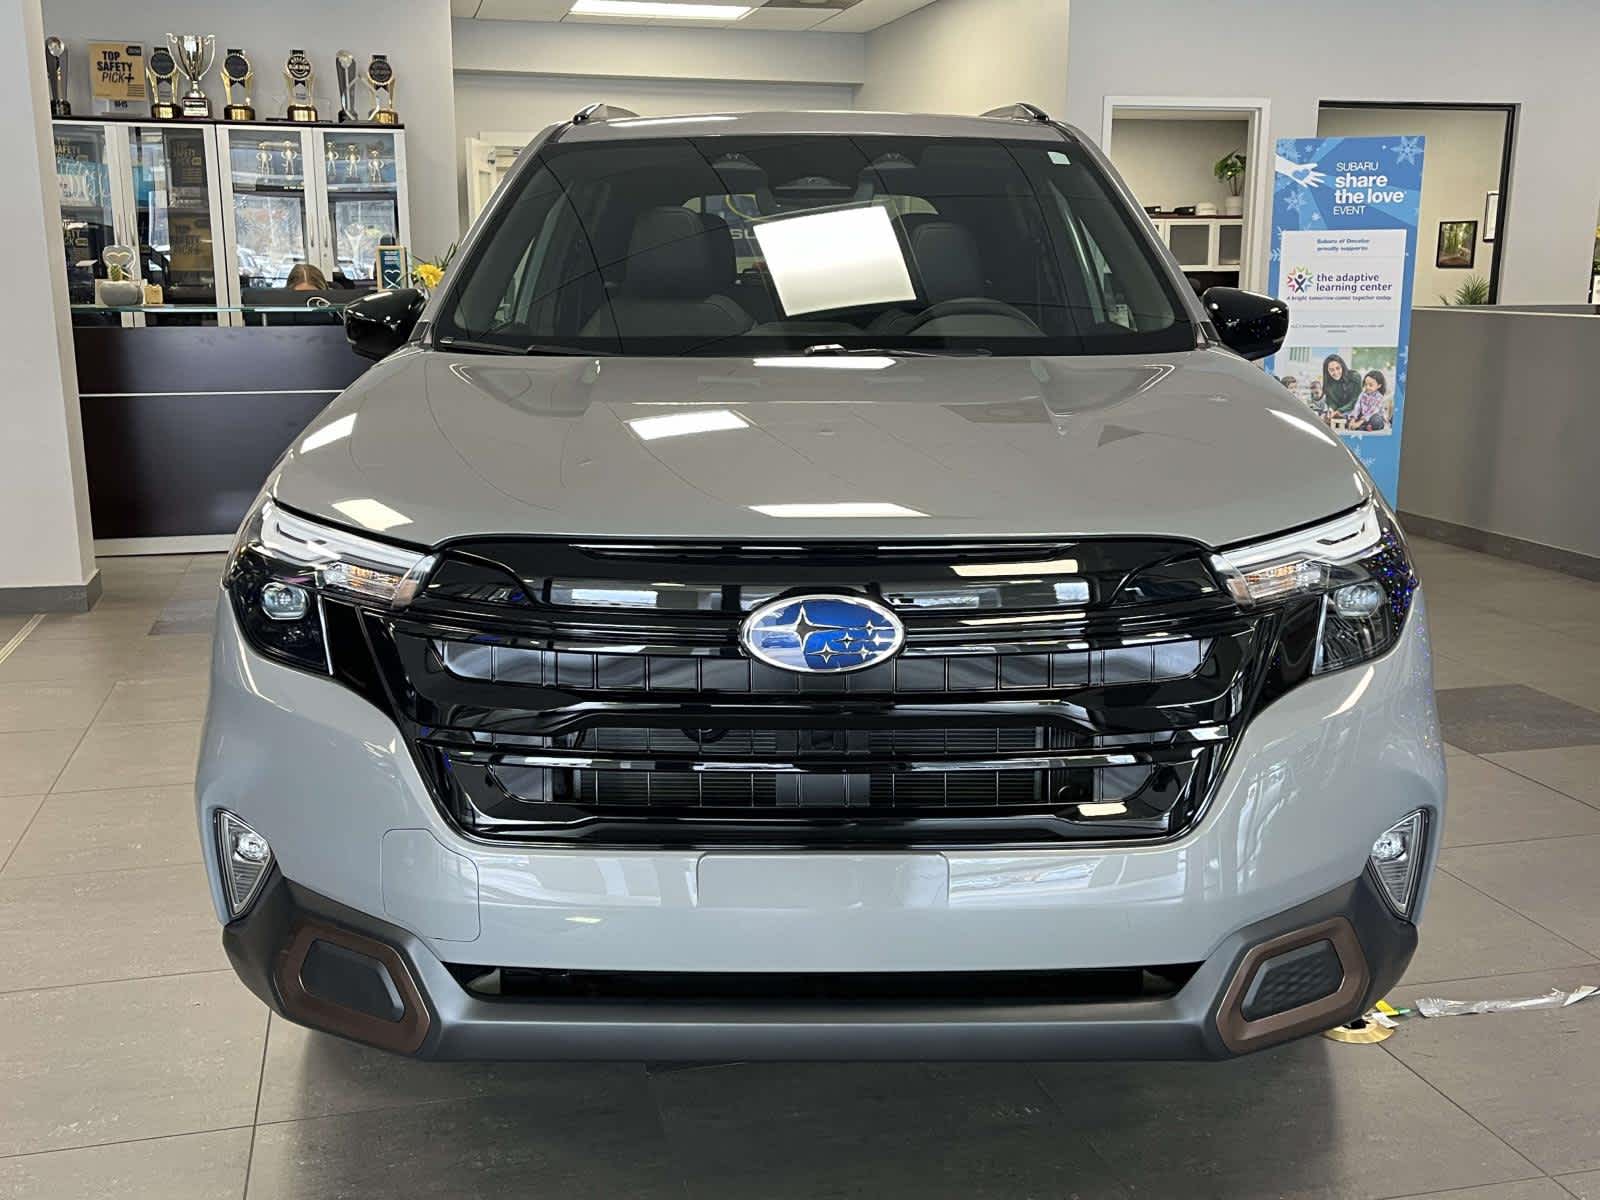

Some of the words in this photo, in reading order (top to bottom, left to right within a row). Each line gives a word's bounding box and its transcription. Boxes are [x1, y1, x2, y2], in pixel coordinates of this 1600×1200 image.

[101, 50, 121, 61] TOP
[96, 61, 133, 72] SAFETY
[101, 72, 135, 83] PICK+
[1335, 161, 1379, 172] SUBARU
[1334, 173, 1388, 189] share
[1334, 189, 1364, 204] the
[1367, 189, 1404, 203] love
[1333, 205, 1366, 216] EVENT
[1317, 272, 1334, 282] the
[1336, 272, 1380, 283] adaptive
[1316, 282, 1357, 293] learning
[1359, 283, 1392, 291] center
